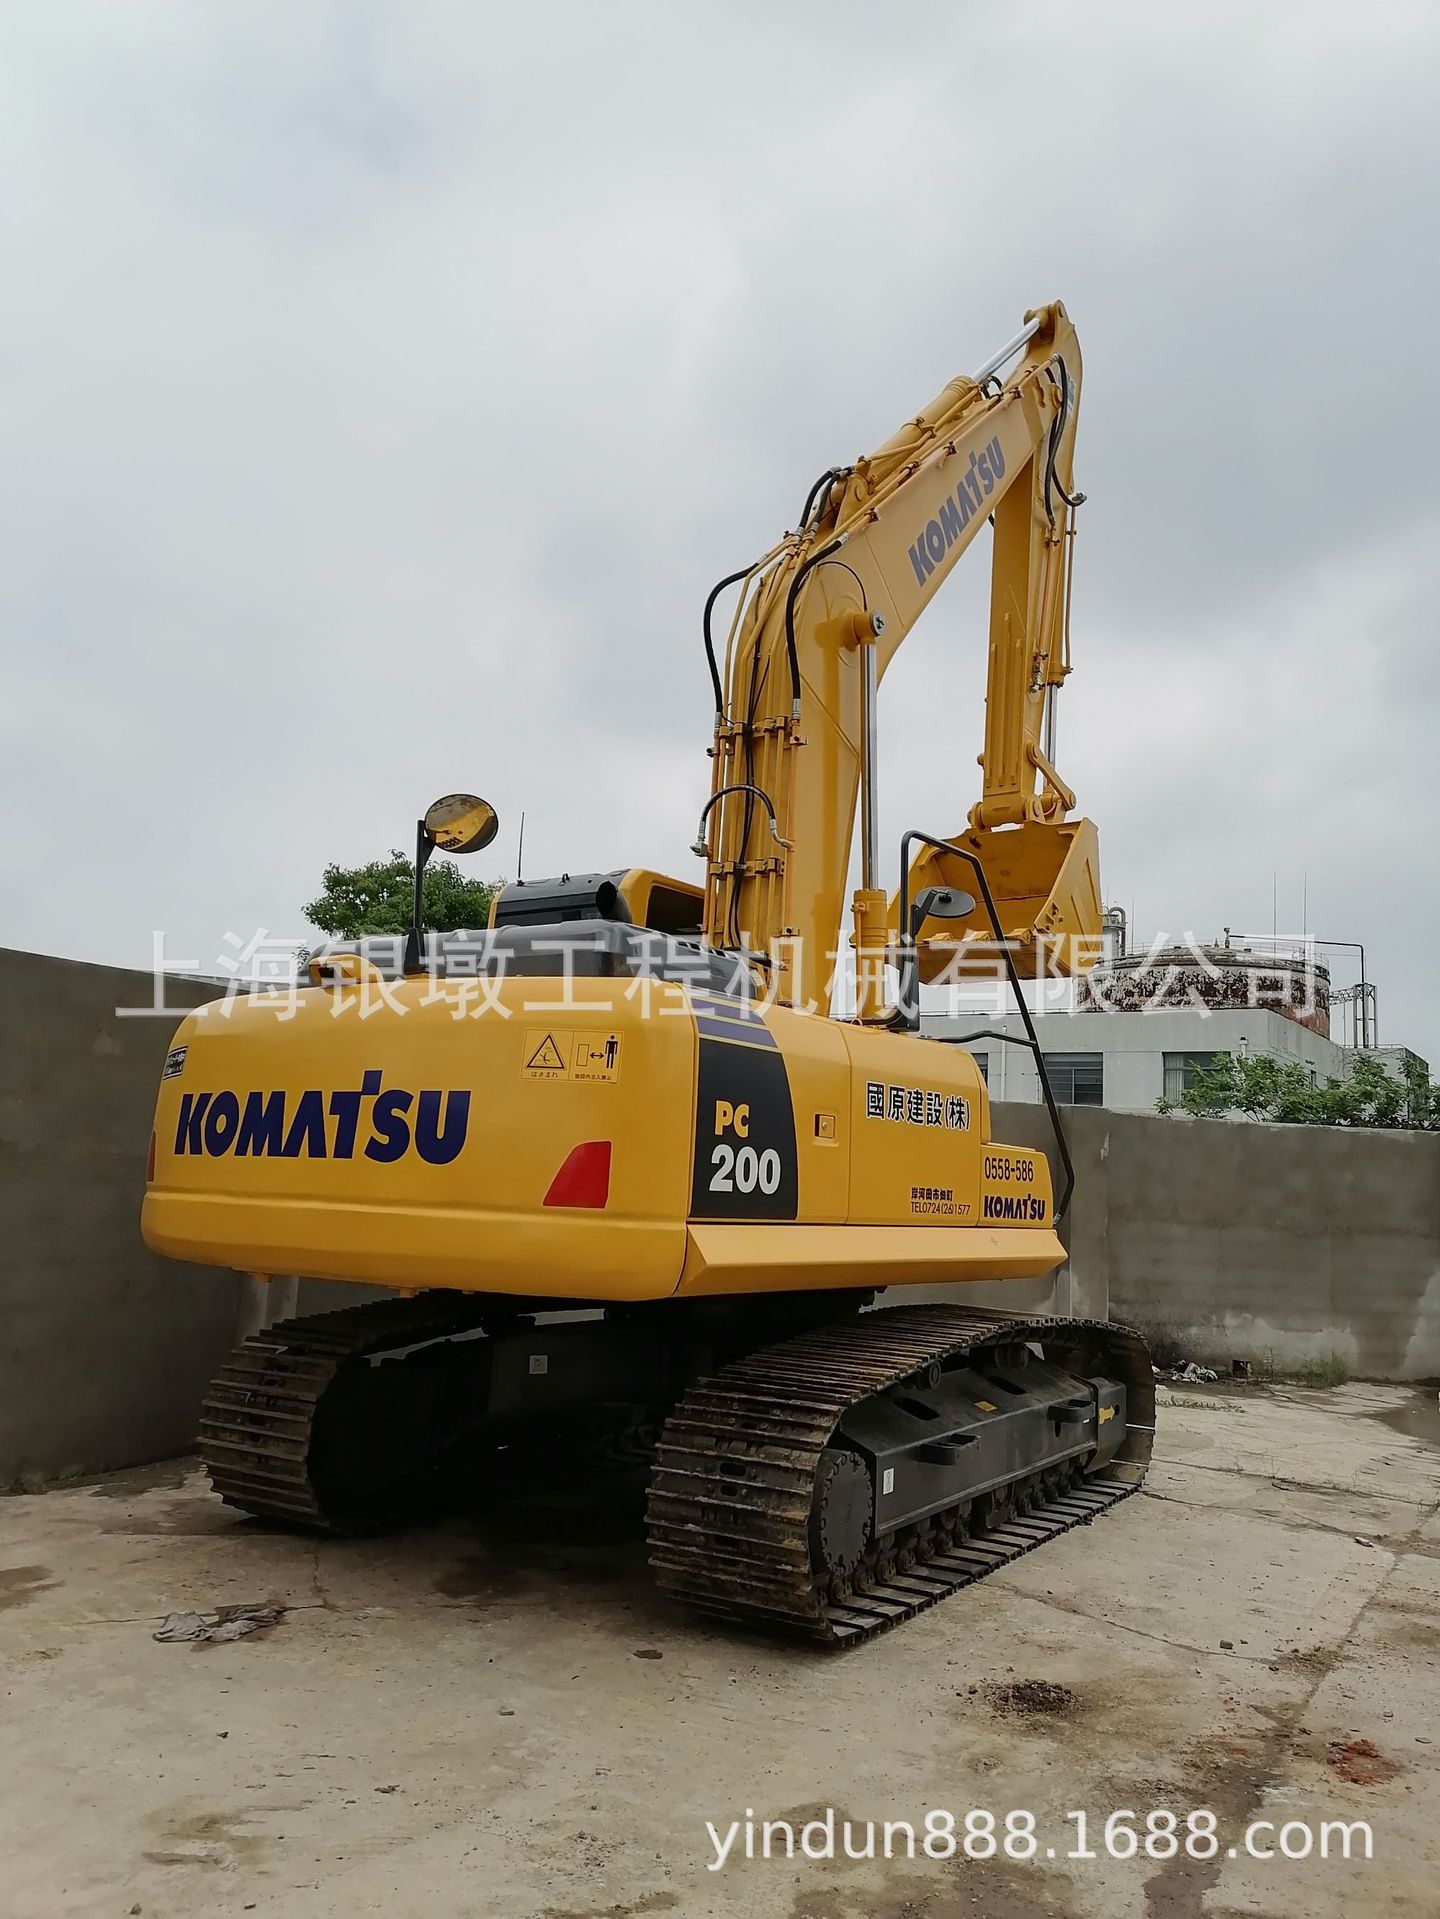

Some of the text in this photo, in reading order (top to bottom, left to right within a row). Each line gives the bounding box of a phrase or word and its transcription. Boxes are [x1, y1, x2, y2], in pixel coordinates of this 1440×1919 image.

[908, 436, 1005, 587] KOMATSU
[174, 1070, 471, 1164] KOMATSU
[714, 1100, 750, 1138] PC
[866, 1081, 971, 1131] 國原建設(株)
[709, 1144, 781, 1195] 200
[984, 1157, 1034, 1183] 0558-586
[983, 1193, 1046, 1221] KOMATSU
